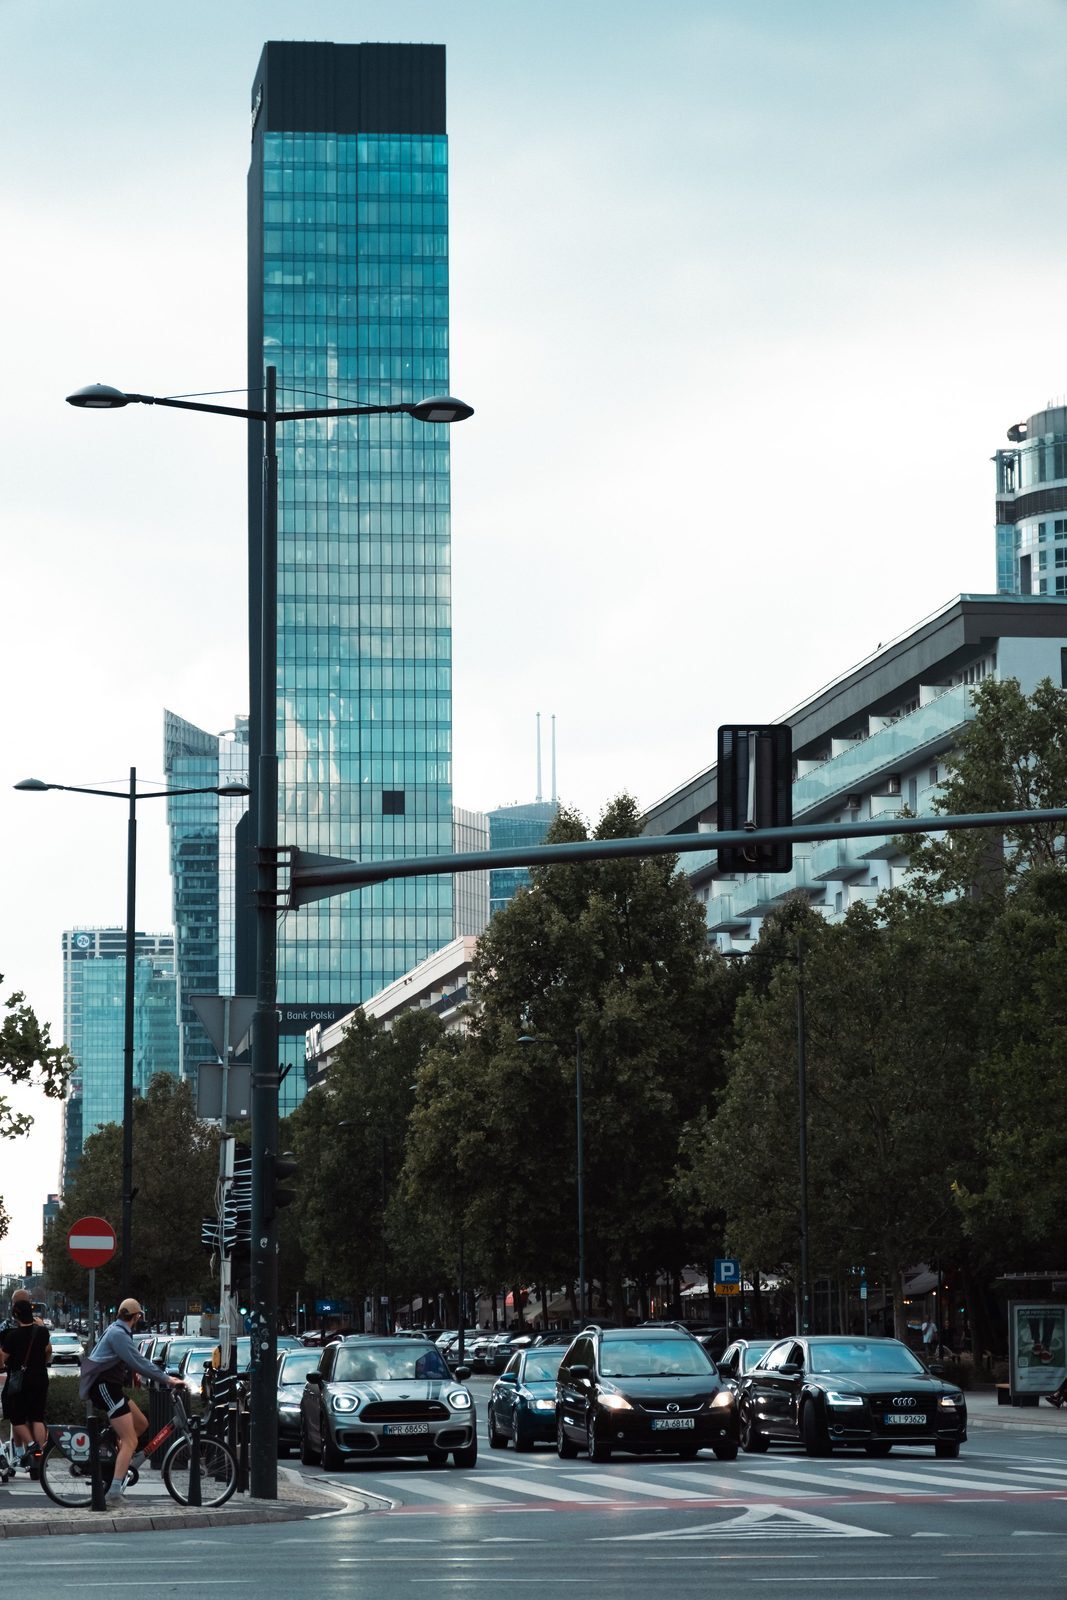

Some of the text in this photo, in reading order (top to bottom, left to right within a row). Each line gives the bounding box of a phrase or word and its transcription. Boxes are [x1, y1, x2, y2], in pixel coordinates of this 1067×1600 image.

[286, 1011, 335, 1020] Bank Polski
[720, 1262, 734, 1281] P
[672, 1420, 693, 1428] 68141
[388, 1425, 402, 1434] WPR
